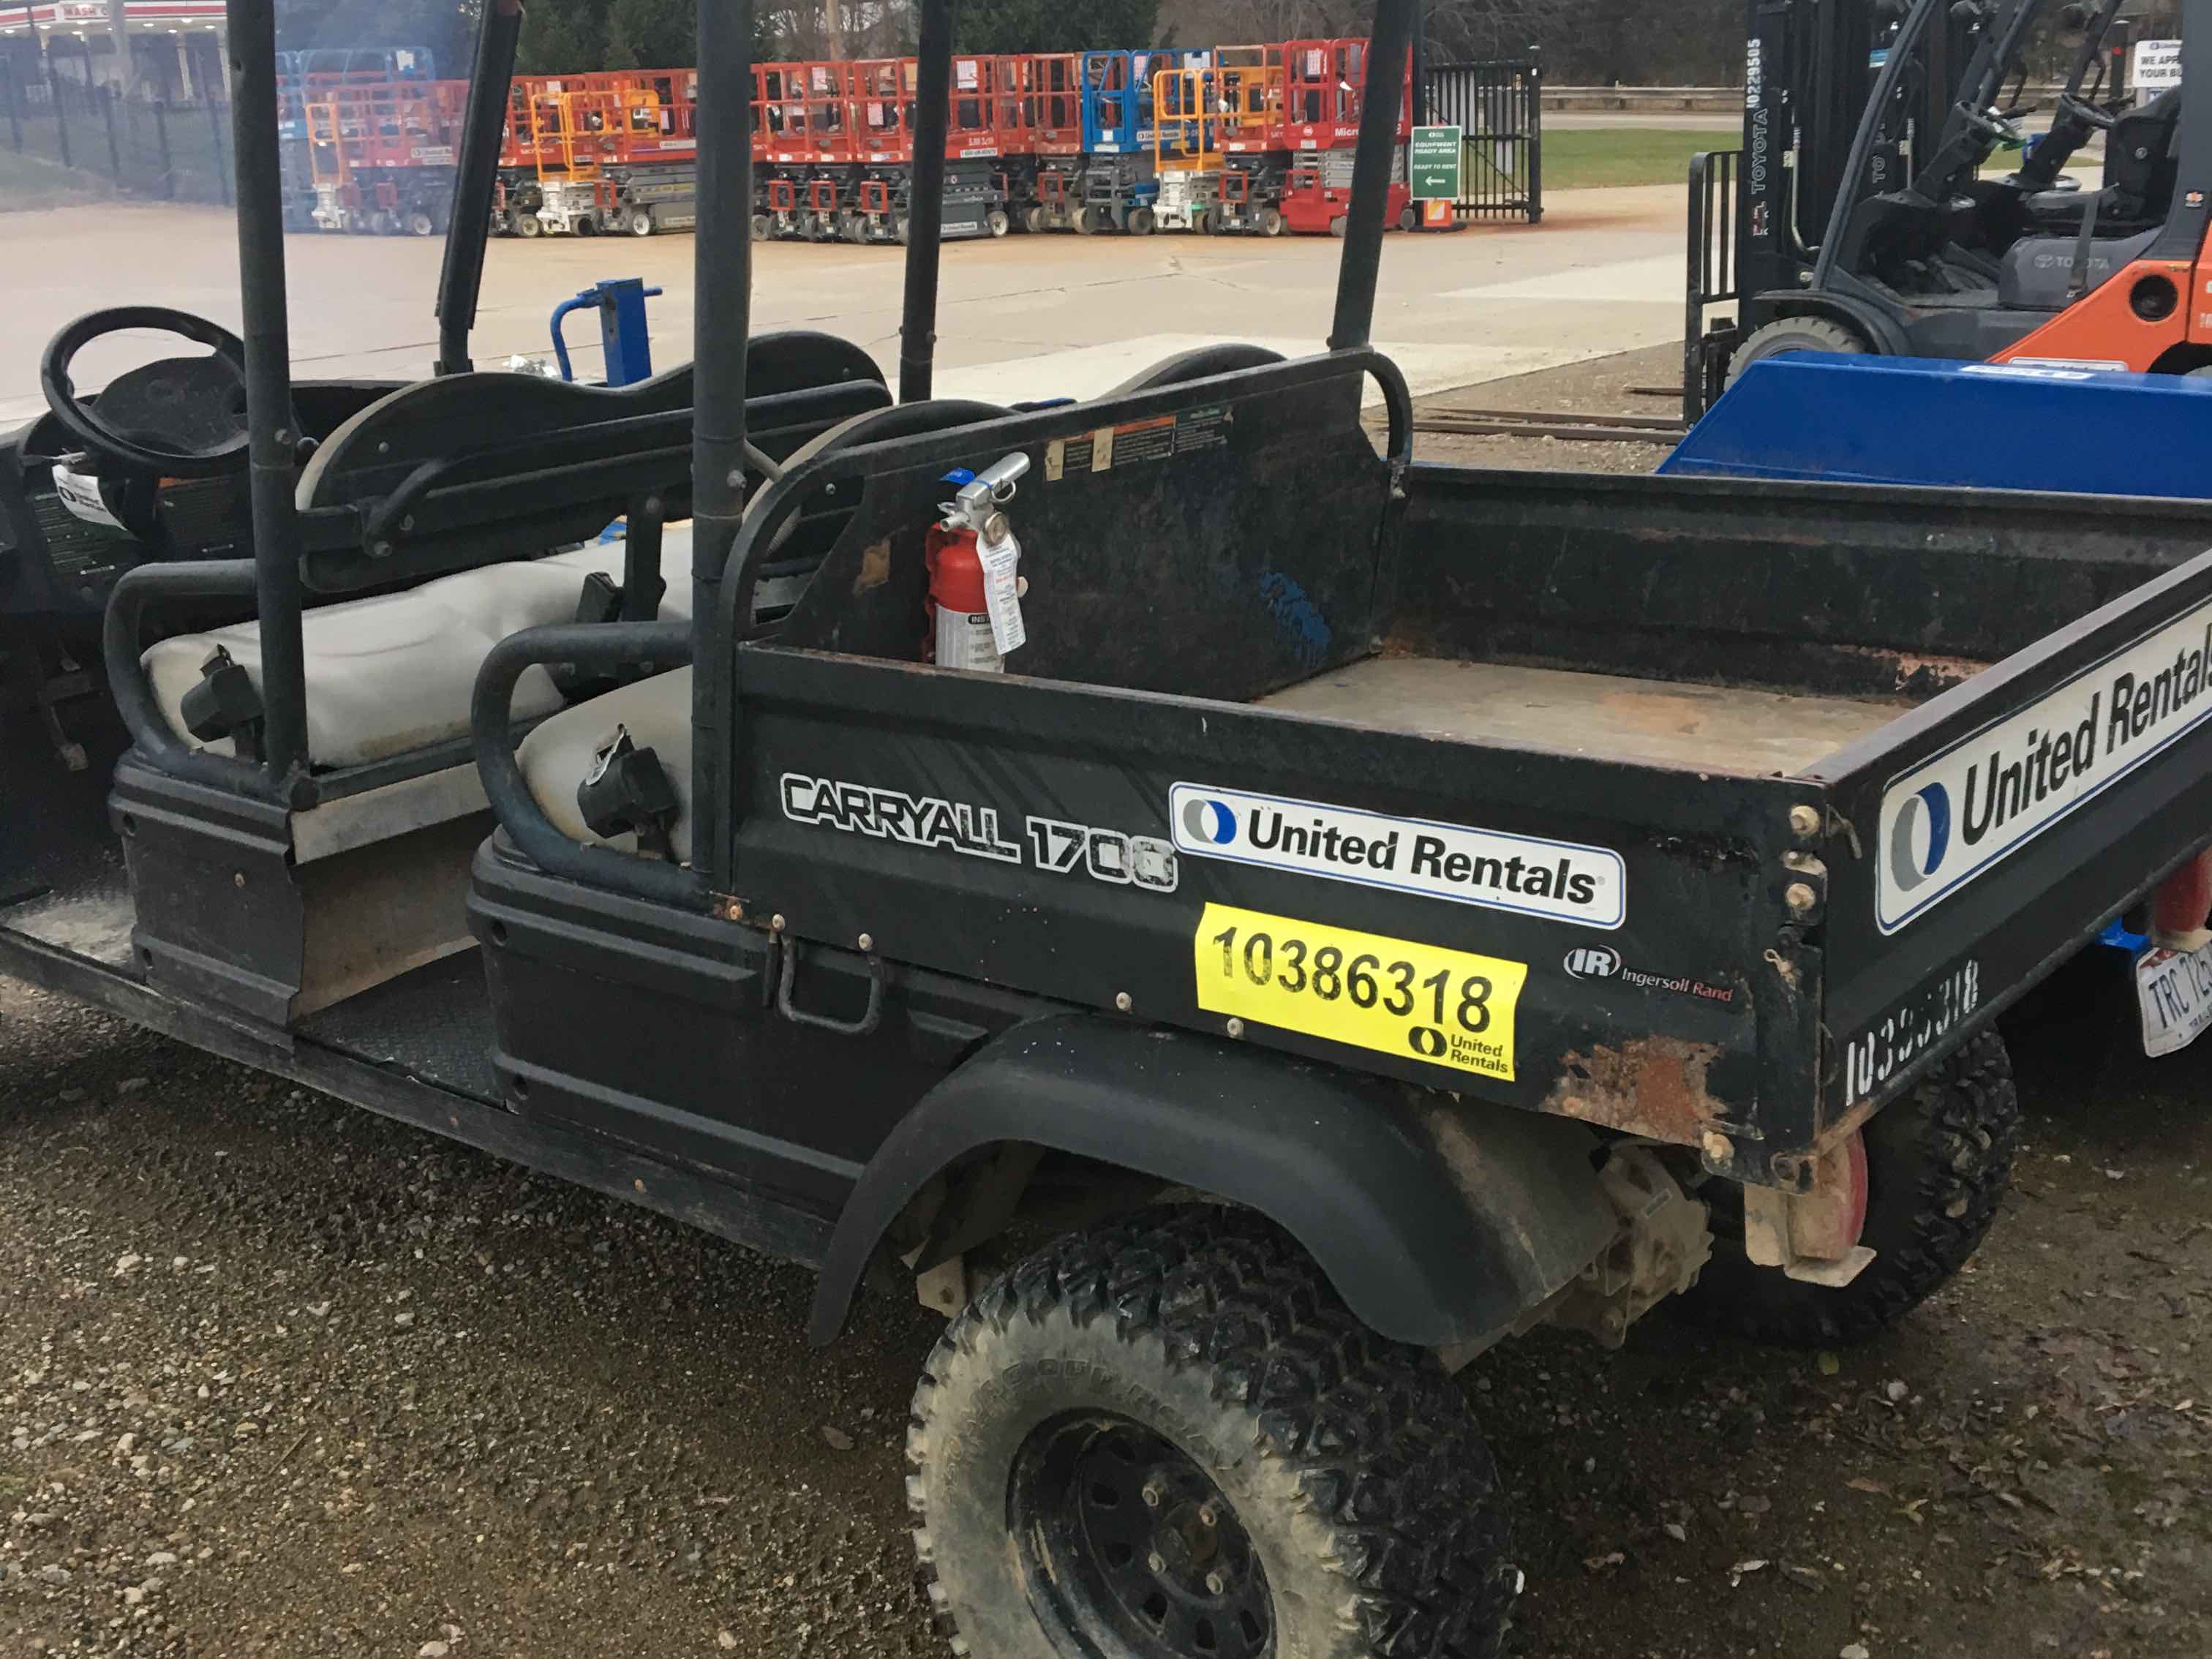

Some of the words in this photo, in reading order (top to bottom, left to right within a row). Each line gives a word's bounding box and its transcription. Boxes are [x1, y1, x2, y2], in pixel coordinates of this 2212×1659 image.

[2140, 69, 2167, 78] YOUR
[1751, 108, 1768, 195] TOYOTA
[1963, 691, 2102, 846] United
[2107, 621, 2212, 756] Rental
[780, 772, 1022, 864] CARRYALL
[1249, 807, 1399, 870] United
[1410, 835, 1596, 905] Rentals
[1212, 925, 1493, 1034] 10386318
[1572, 948, 1612, 977] IR
[1622, 968, 1690, 992] Ingersoll
[1693, 982, 1734, 1002] Rand
[1451, 1034, 1503, 1058] United
[1451, 1049, 1508, 1074] Rentals
